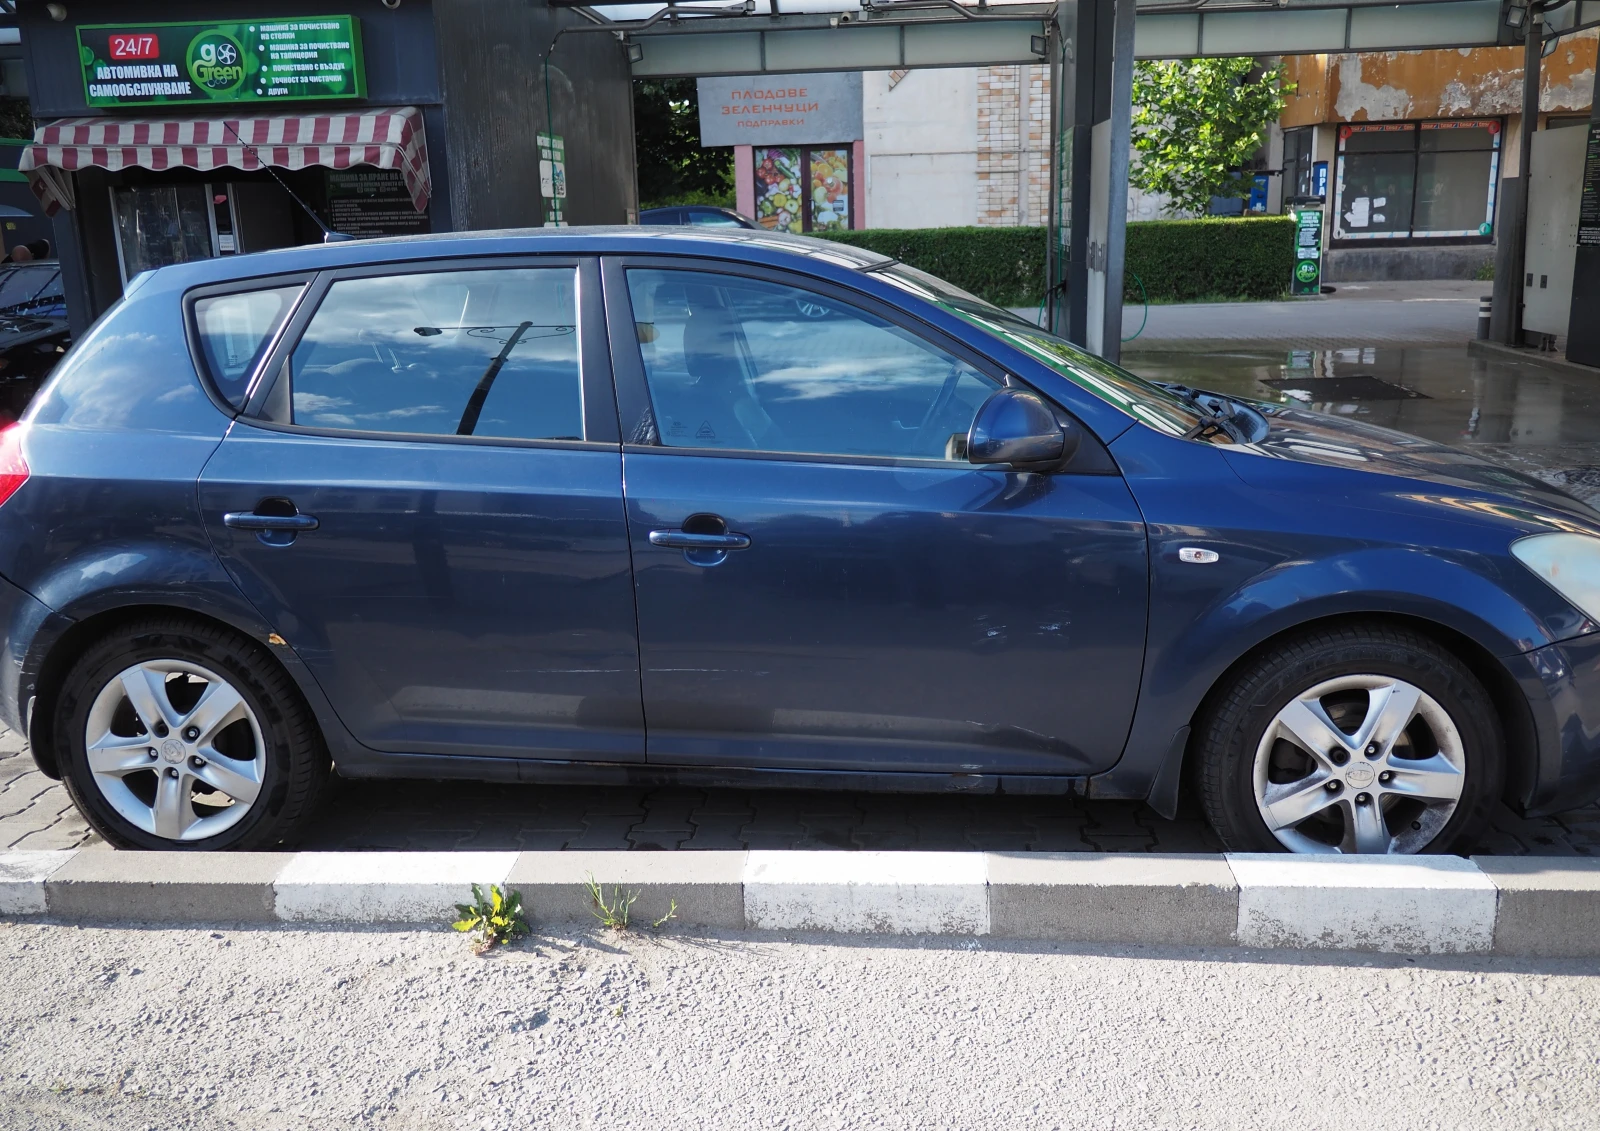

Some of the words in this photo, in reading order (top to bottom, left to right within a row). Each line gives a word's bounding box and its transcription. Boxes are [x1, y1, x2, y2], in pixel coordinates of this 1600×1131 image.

[299, 22, 340, 31] почистване
[270, 32, 295, 40] стелки
[114, 37, 153, 56] 24/7
[269, 43, 299, 51] машина
[308, 41, 350, 50] почистване
[97, 64, 163, 80] АВТОМИВКА
[163, 64, 179, 78] НА
[192, 60, 243, 83] Green
[272, 63, 314, 72] почистване
[319, 62, 345, 71] въздух
[271, 76, 299, 84] течност
[309, 74, 342, 82] чистачки
[89, 82, 192, 97] САМООБСЛУЖВАНЕ
[268, 87, 289, 96] други
[731, 88, 808, 100] ПЛОДОВЕ
[721, 102, 819, 115] ЗЕЛЕНЧУЦИ
[737, 118, 805, 128] ПОДПРАВКИ
